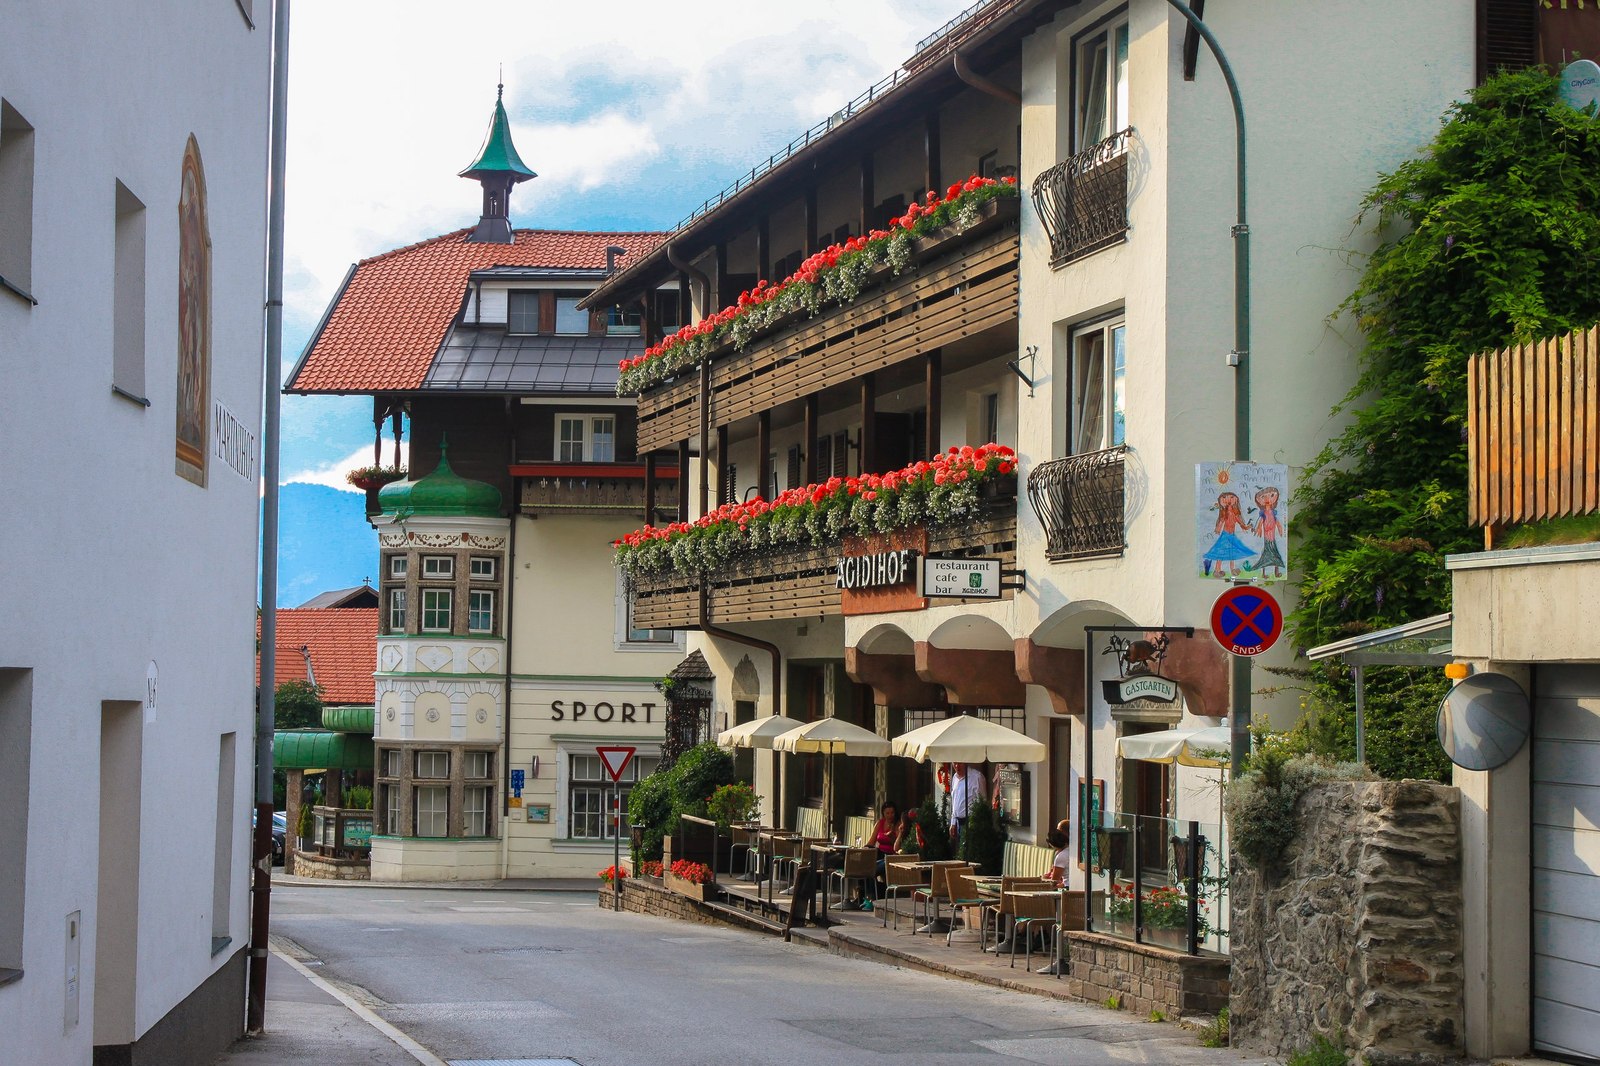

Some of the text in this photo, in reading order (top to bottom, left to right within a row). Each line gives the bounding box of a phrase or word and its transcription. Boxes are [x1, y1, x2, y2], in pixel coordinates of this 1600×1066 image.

[1571, 78, 1596, 88] CityCom
[214, 403, 255, 482] MARTINIHOF
[935, 562, 990, 571] restaurant
[935, 573, 958, 583] cafe
[935, 585, 953, 594] bar
[1231, 644, 1263, 655] ENDE
[1125, 680, 1172, 696] GASTGARTEN
[551, 700, 657, 723] SPORT
